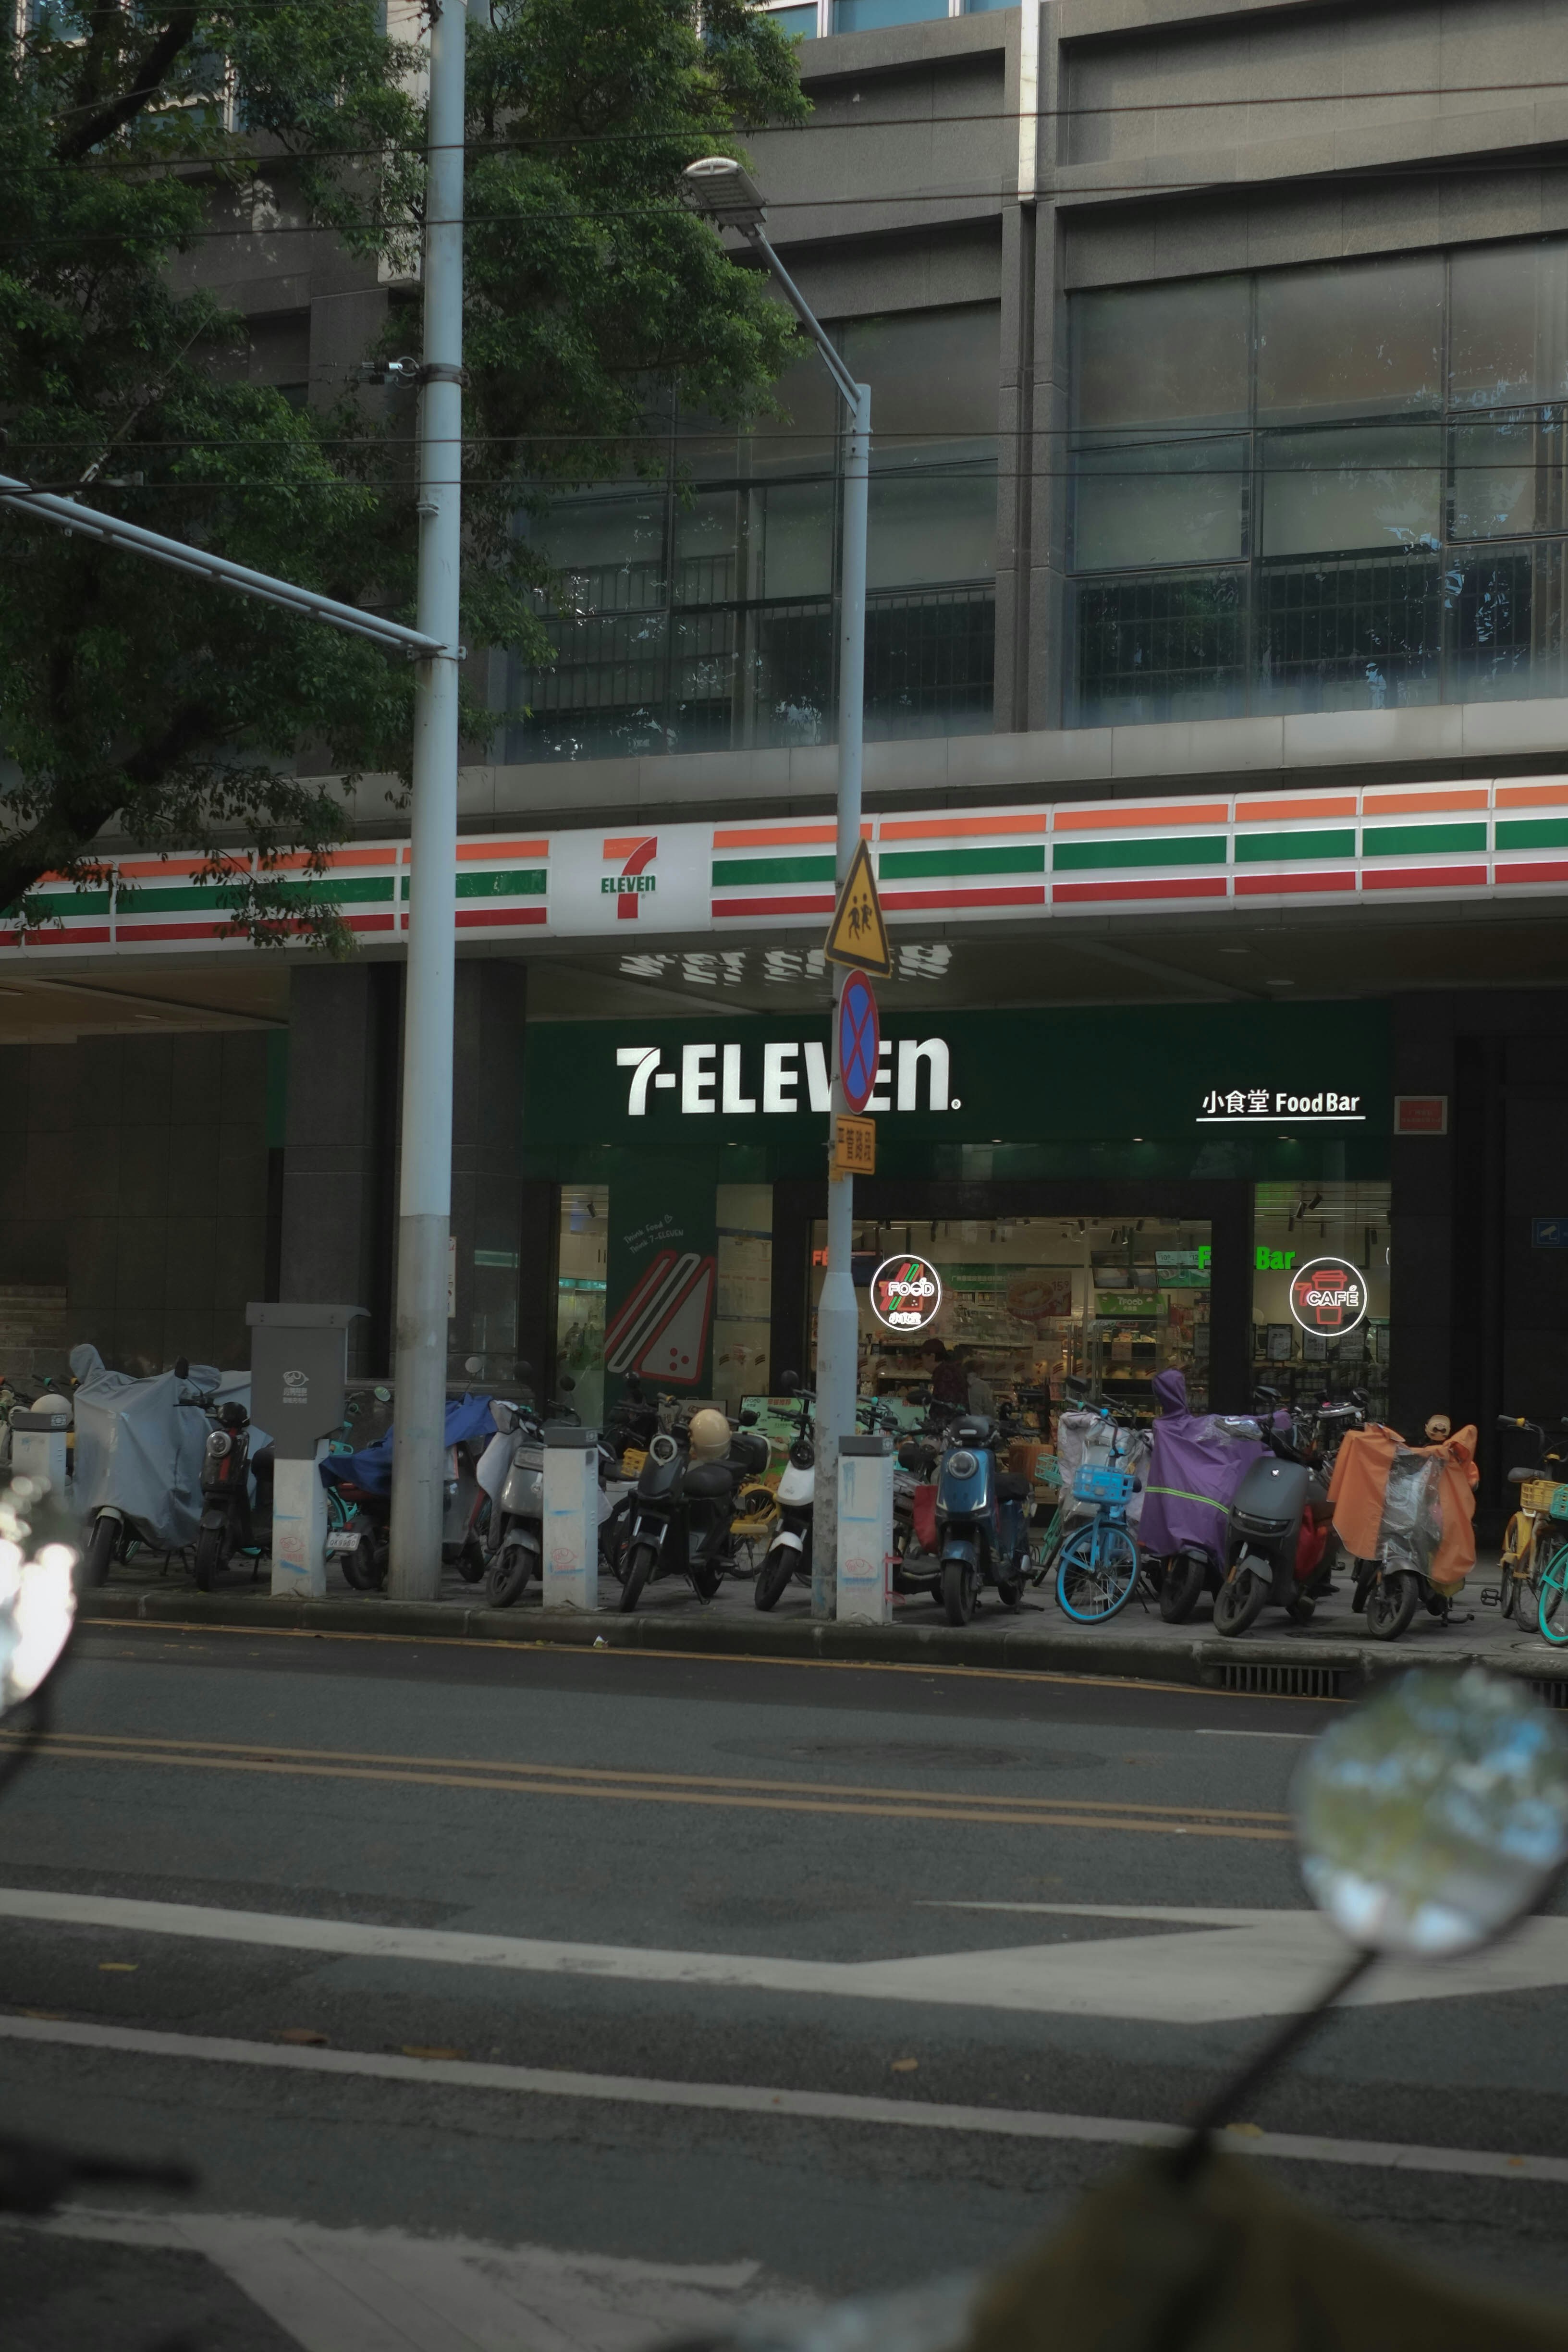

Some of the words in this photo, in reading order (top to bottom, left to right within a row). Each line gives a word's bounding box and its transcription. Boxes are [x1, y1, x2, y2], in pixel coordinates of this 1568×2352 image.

[1202, 1089, 1270, 1114] 小食堂
[1275, 1093, 1323, 1112] Food
[1326, 1093, 1360, 1112] Bar
[1256, 1246, 1296, 1270] Bar
